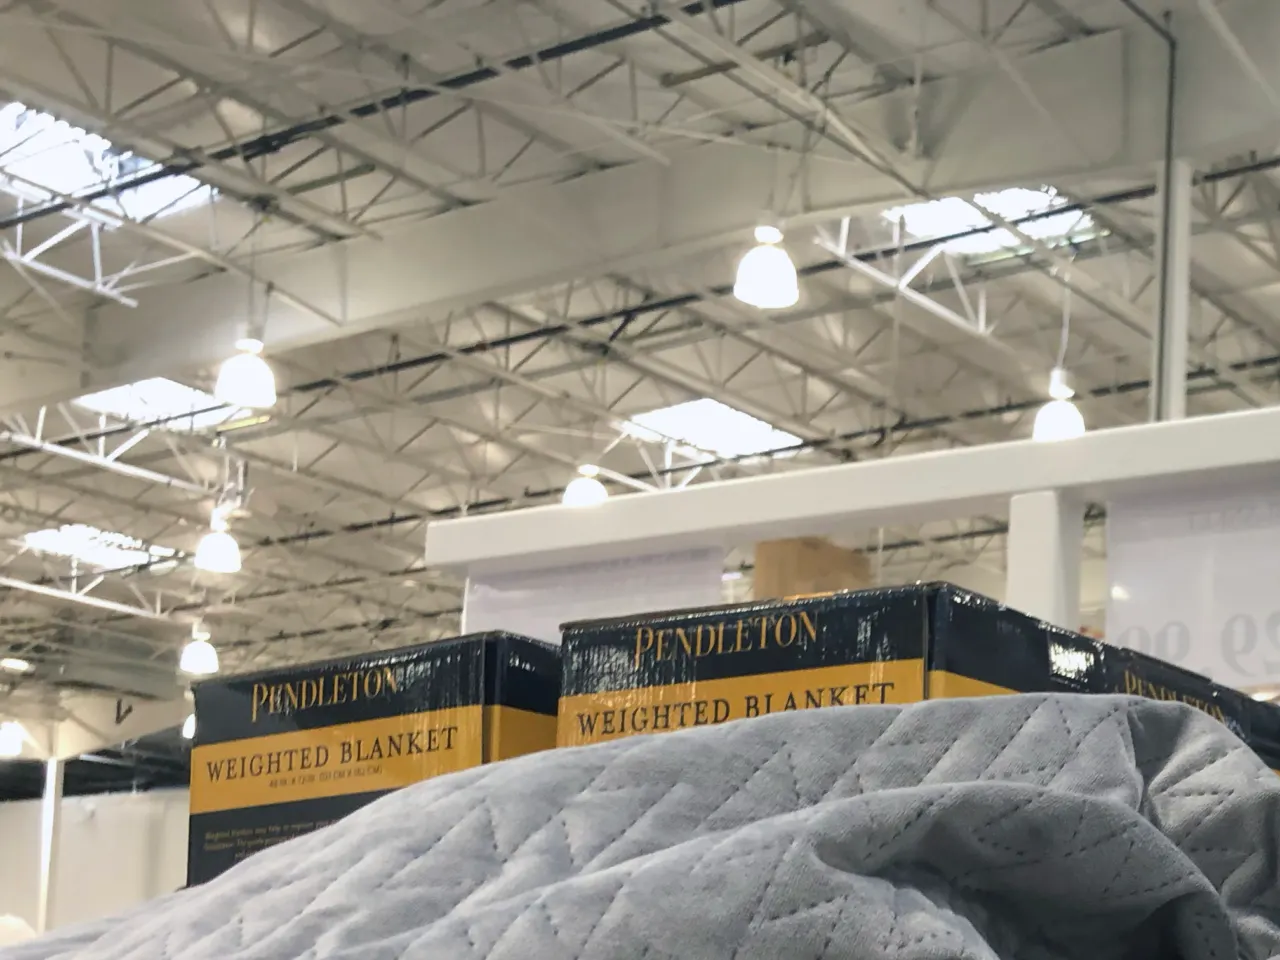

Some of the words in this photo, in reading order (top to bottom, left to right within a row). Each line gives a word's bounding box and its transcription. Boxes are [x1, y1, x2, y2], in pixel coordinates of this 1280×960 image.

[635, 610, 819, 668] PENDLETON
[252, 665, 398, 722] PENDLETON
[577, 698, 730, 737] WEIGHTED
[207, 745, 330, 783] WEIGHTED
[340, 726, 459, 764] BLANKET
